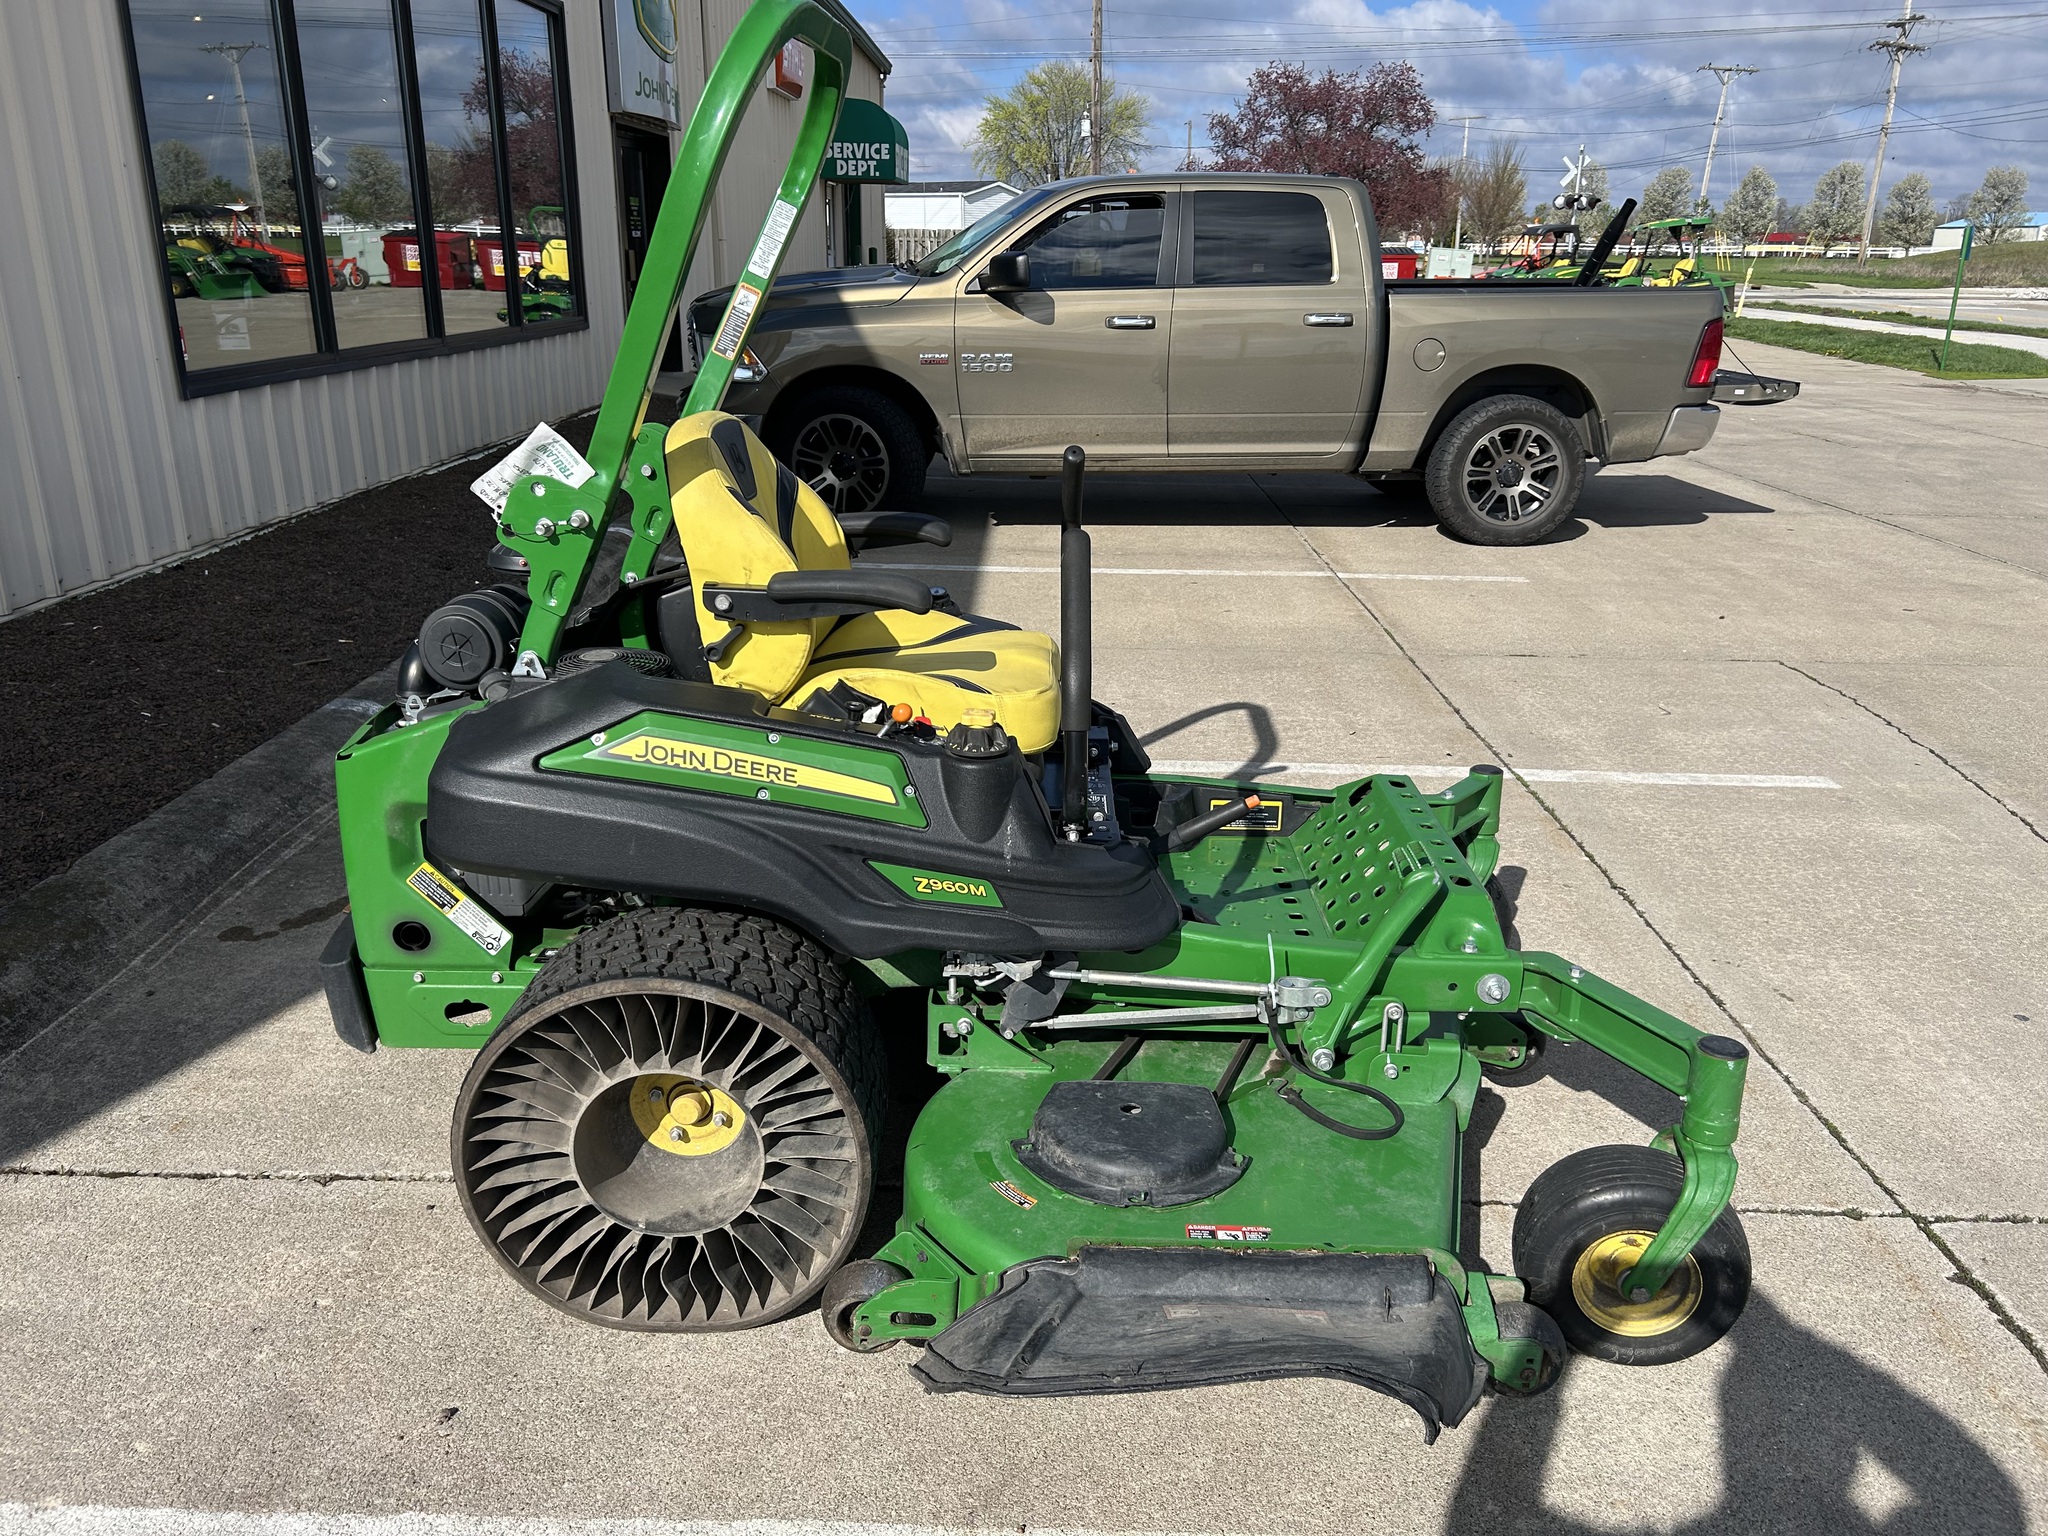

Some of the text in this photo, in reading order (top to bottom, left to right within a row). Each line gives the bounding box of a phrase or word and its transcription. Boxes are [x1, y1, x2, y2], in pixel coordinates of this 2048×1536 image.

[635, 71, 665, 103] JOHN
[836, 159, 880, 177] DEPT.
[961, 353, 1014, 364] RAM
[961, 363, 1014, 373] 1500
[535, 444, 575, 480] TRULAND
[635, 740, 798, 784] JOHN DEERE
[434, 874, 455, 893] CAUTION
[912, 876, 987, 898] Z960M
